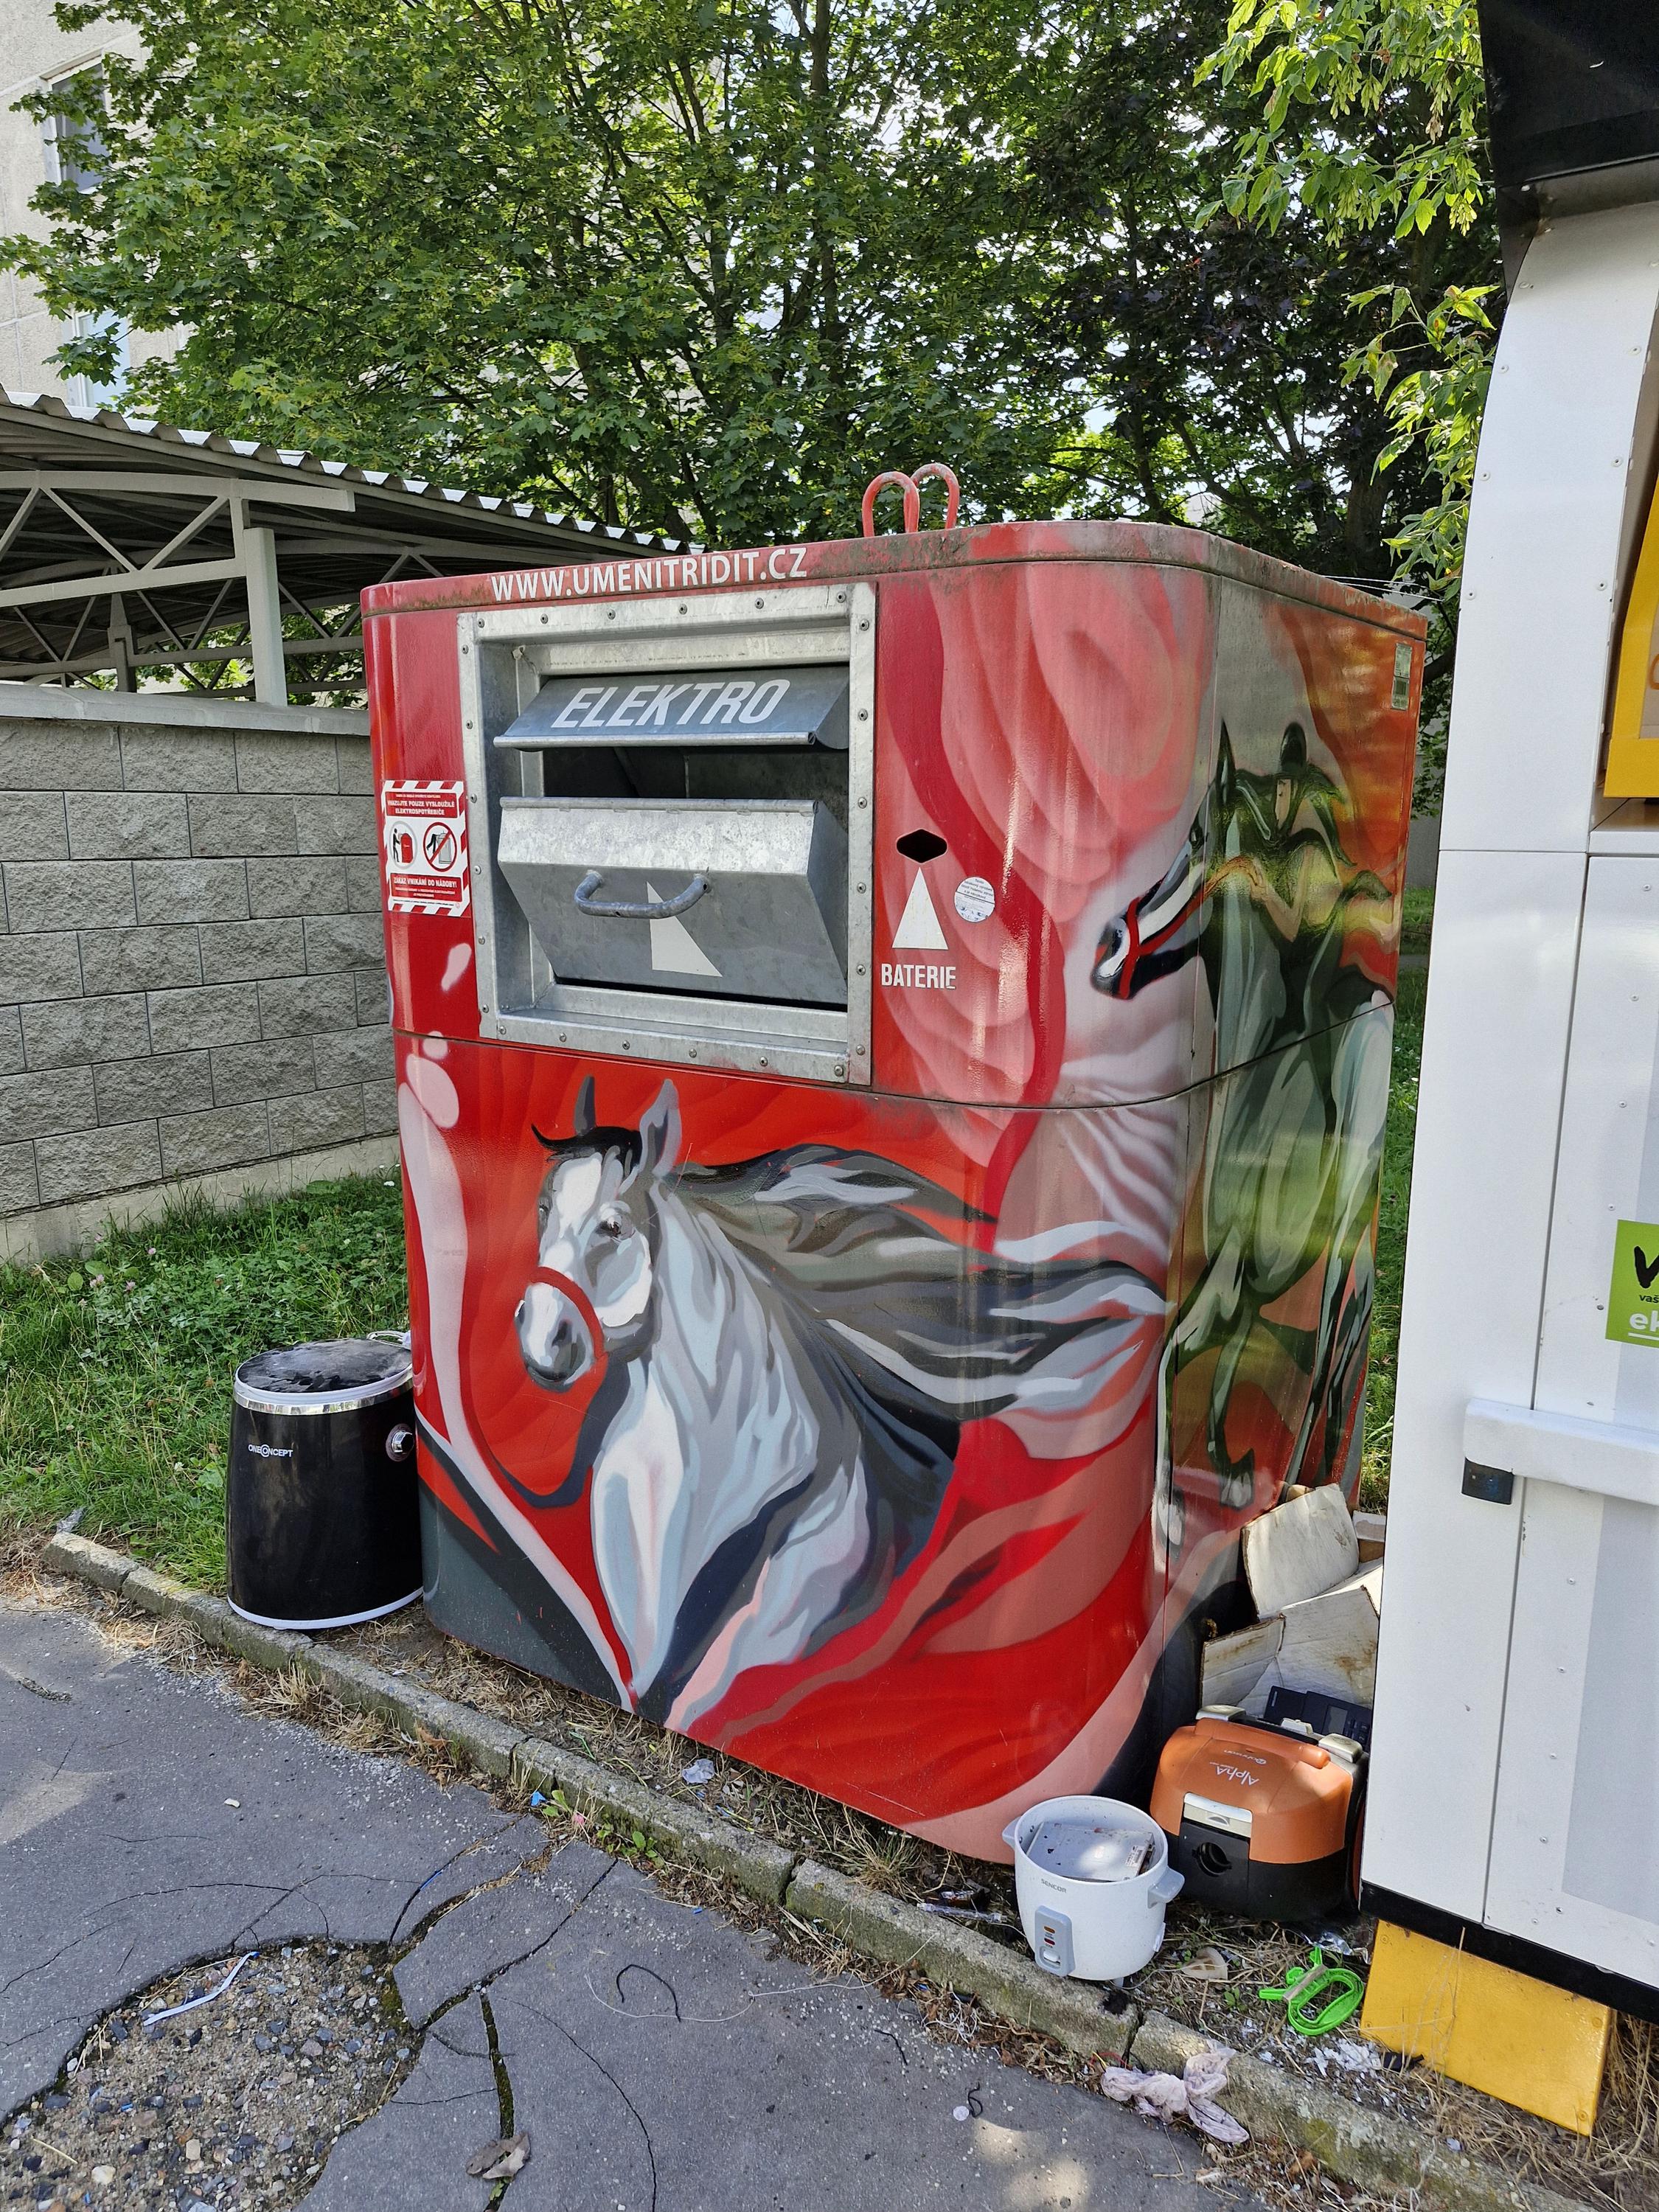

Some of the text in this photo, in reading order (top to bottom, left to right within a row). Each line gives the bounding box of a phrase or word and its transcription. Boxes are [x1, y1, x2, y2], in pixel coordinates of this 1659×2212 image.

[491, 547, 807, 602] WWW.UMENITRIDIT.CZ
[551, 679, 790, 728] ELEKTRO
[394, 876, 406, 884] ZÁKAZ
[881, 963, 956, 990] BATERIE
[1041, 1879, 1067, 1893] SENCOR
